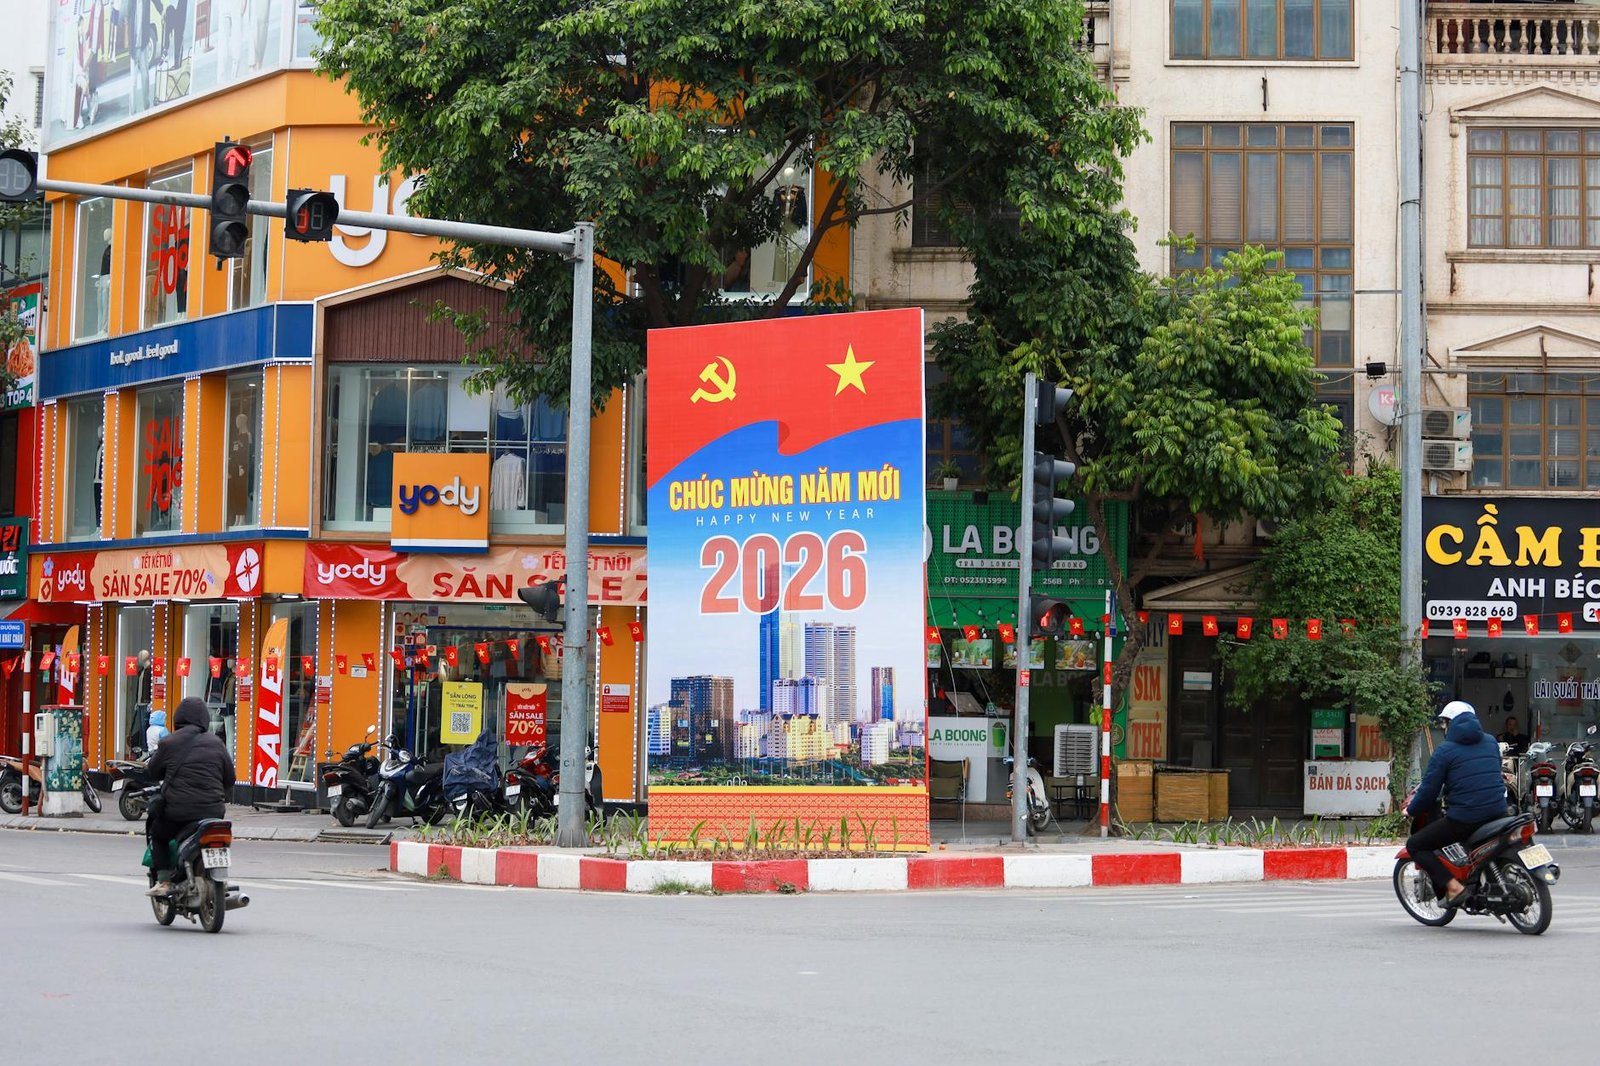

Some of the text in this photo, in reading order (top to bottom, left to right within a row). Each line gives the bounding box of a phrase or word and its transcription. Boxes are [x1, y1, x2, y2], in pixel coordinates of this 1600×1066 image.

[7, 391, 25, 406] TOP
[399, 476, 480, 515] yody
[669, 463, 900, 511] CHÚC MỪNG NĂM MỚI
[696, 508, 875, 527] HAPPY NEW YEAR
[943, 524, 982, 554] LA
[1425, 503, 1562, 567] CẦM
[317, 558, 386, 586] yody
[605, 552, 631, 570] NỐI
[700, 529, 868, 616] 2026
[58, 563, 85, 592] yody
[103, 570, 129, 597] SĂN
[134, 573, 169, 597] SALE
[173, 569, 207, 596] 70%
[432, 567, 513, 599] SĂN
[1487, 578, 1545, 597] ANH
[1430, 605, 1514, 617] 0939 828 668
[1134, 665, 1162, 702] SIM
[1553, 676, 1578, 698] SUẤT
[509, 720, 543, 734] 70%
[945, 729, 986, 742] BOONG
[1356, 776, 1386, 793] SẠCH
